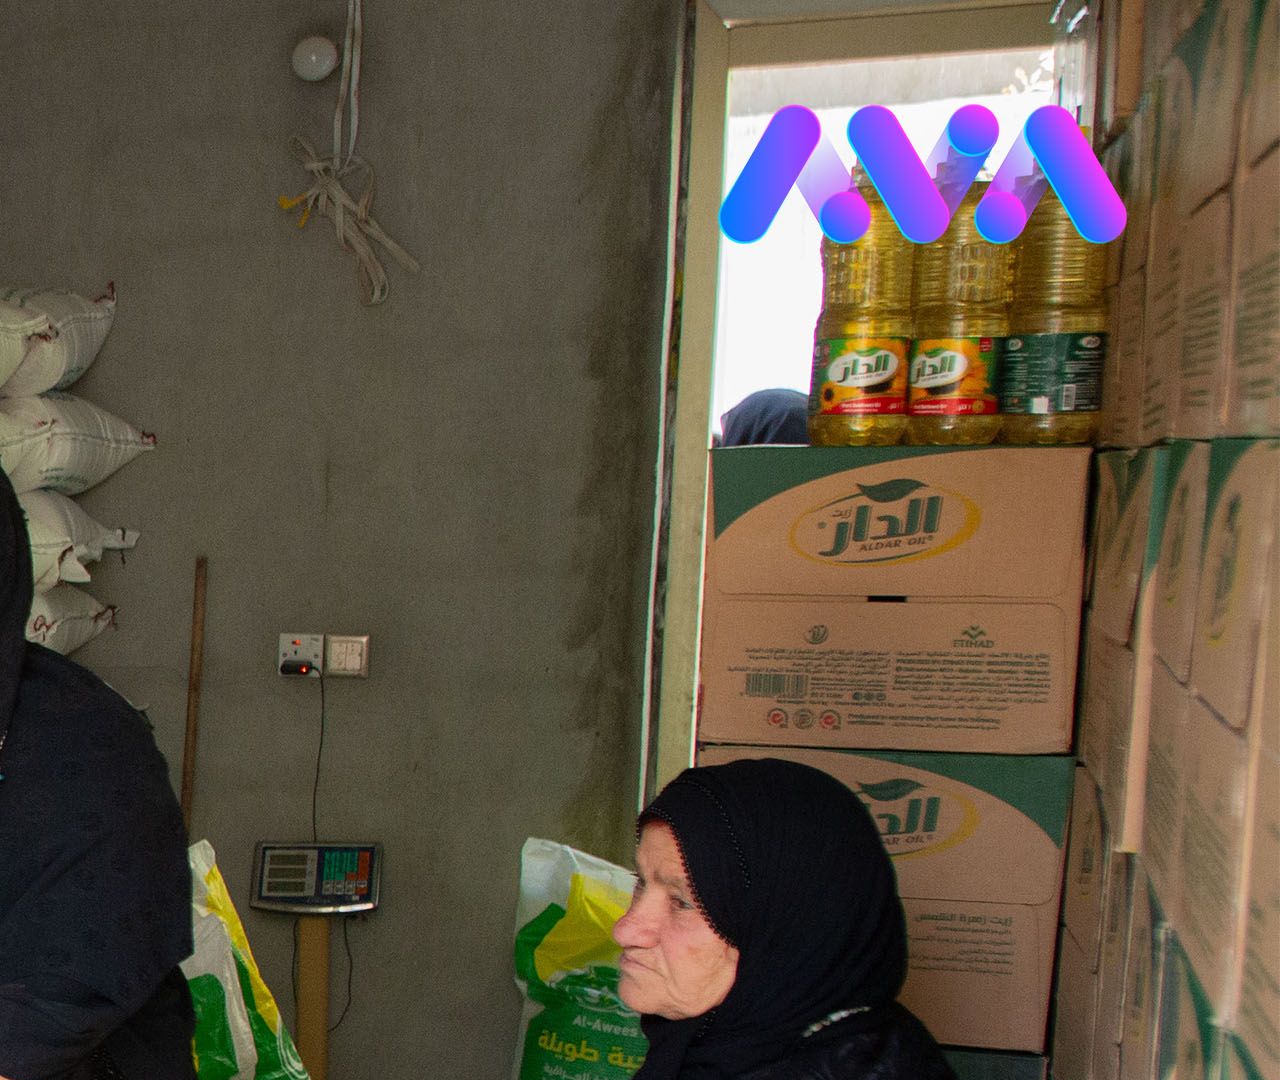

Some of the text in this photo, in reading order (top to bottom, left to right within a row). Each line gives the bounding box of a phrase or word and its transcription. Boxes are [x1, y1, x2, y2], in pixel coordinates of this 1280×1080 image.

[837, 355, 889, 383] الدار
[818, 496, 944, 557] الدار
[859, 538, 928, 553] ALDAR OIL
[953, 639, 995, 649] ETIHAD
[864, 796, 941, 836] الد
[572, 1013, 640, 1038] Al-Awees
[538, 1028, 601, 1062] طويلة
